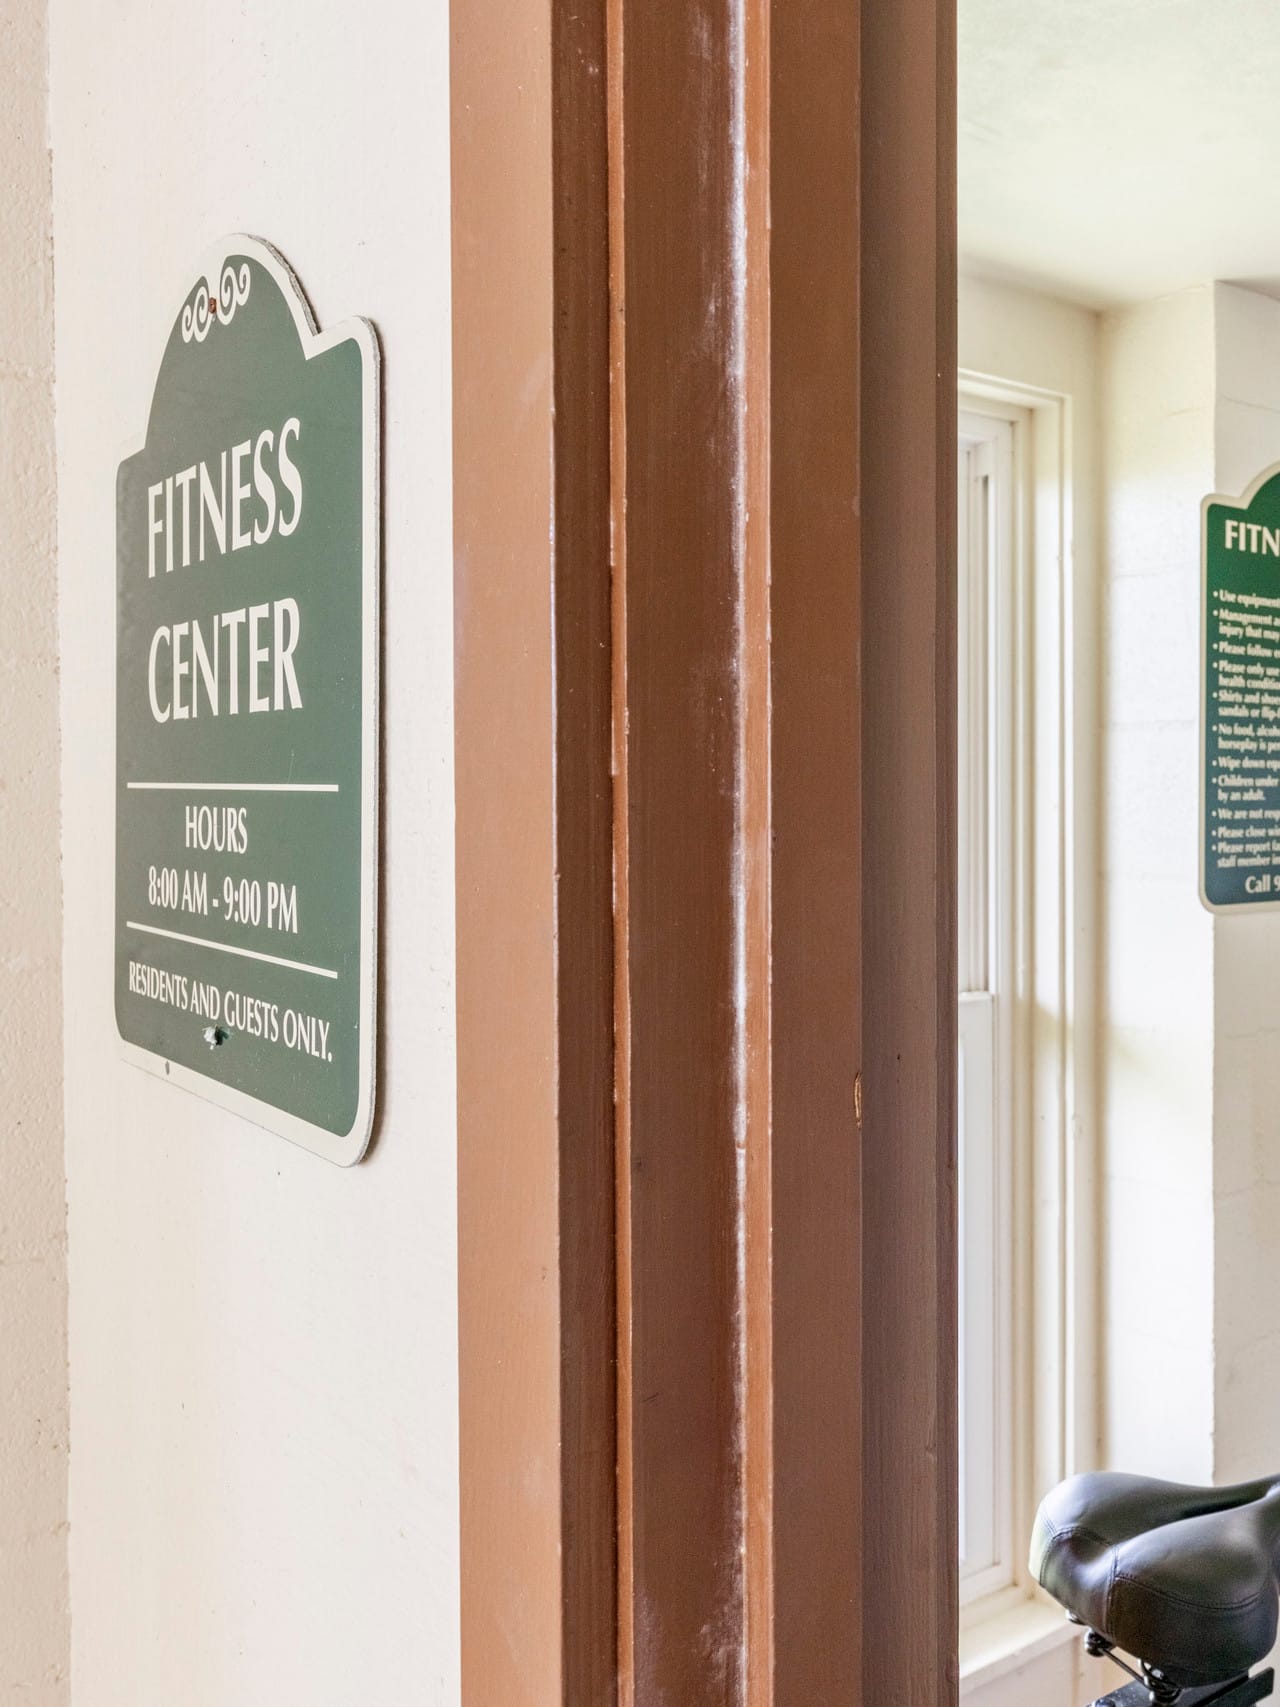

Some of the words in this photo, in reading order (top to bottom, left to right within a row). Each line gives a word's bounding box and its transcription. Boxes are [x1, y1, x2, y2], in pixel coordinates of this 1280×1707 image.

[148, 417, 302, 579] FITNESS
[1219, 589, 1236, 602] Use
[1237, 593, 1280, 608] equipment
[1219, 608, 1272, 625] Management
[1219, 622, 1243, 639] injury
[1245, 625, 1262, 638] that
[1263, 630, 1280, 643] may
[1219, 641, 1246, 655] Please
[1246, 643, 1272, 657] follow
[148, 597, 303, 723] CENTER
[1219, 660, 1246, 674] Please
[1246, 662, 1264, 678] only
[1219, 673, 1246, 688] health
[1243, 692, 1260, 704] and
[1218, 704, 1249, 717] sandals
[1218, 723, 1232, 735] No
[1233, 723, 1255, 737] food,
[1218, 736, 1258, 753] horseplay
[1218, 756, 1241, 771] Wipe
[1242, 756, 1266, 768] down
[1218, 774, 1254, 787] Children
[1255, 775, 1279, 787] under
[1217, 788, 1229, 804] by
[1229, 791, 1242, 801] an
[1218, 808, 1233, 819] We
[1233, 810, 1248, 819] are
[1249, 808, 1263, 819] not
[185, 805, 248, 854] HOURS
[1218, 826, 1244, 838] Please
[1245, 825, 1267, 838] close
[1217, 841, 1244, 853] Please
[1245, 841, 1270, 855] report
[1217, 854, 1236, 868] staff
[1237, 853, 1270, 867] member
[1245, 874, 1271, 894] Call
[148, 865, 178, 910] 8:00
[181, 869, 208, 916] AM
[212, 898, 219, 908] -
[223, 876, 261, 926] 9:00
[267, 881, 298, 934] PM
[129, 961, 188, 1010] RESIDENTS
[190, 980, 220, 1021] AND
[224, 990, 280, 1043] GUESTS
[283, 1009, 333, 1062] ONLY.
